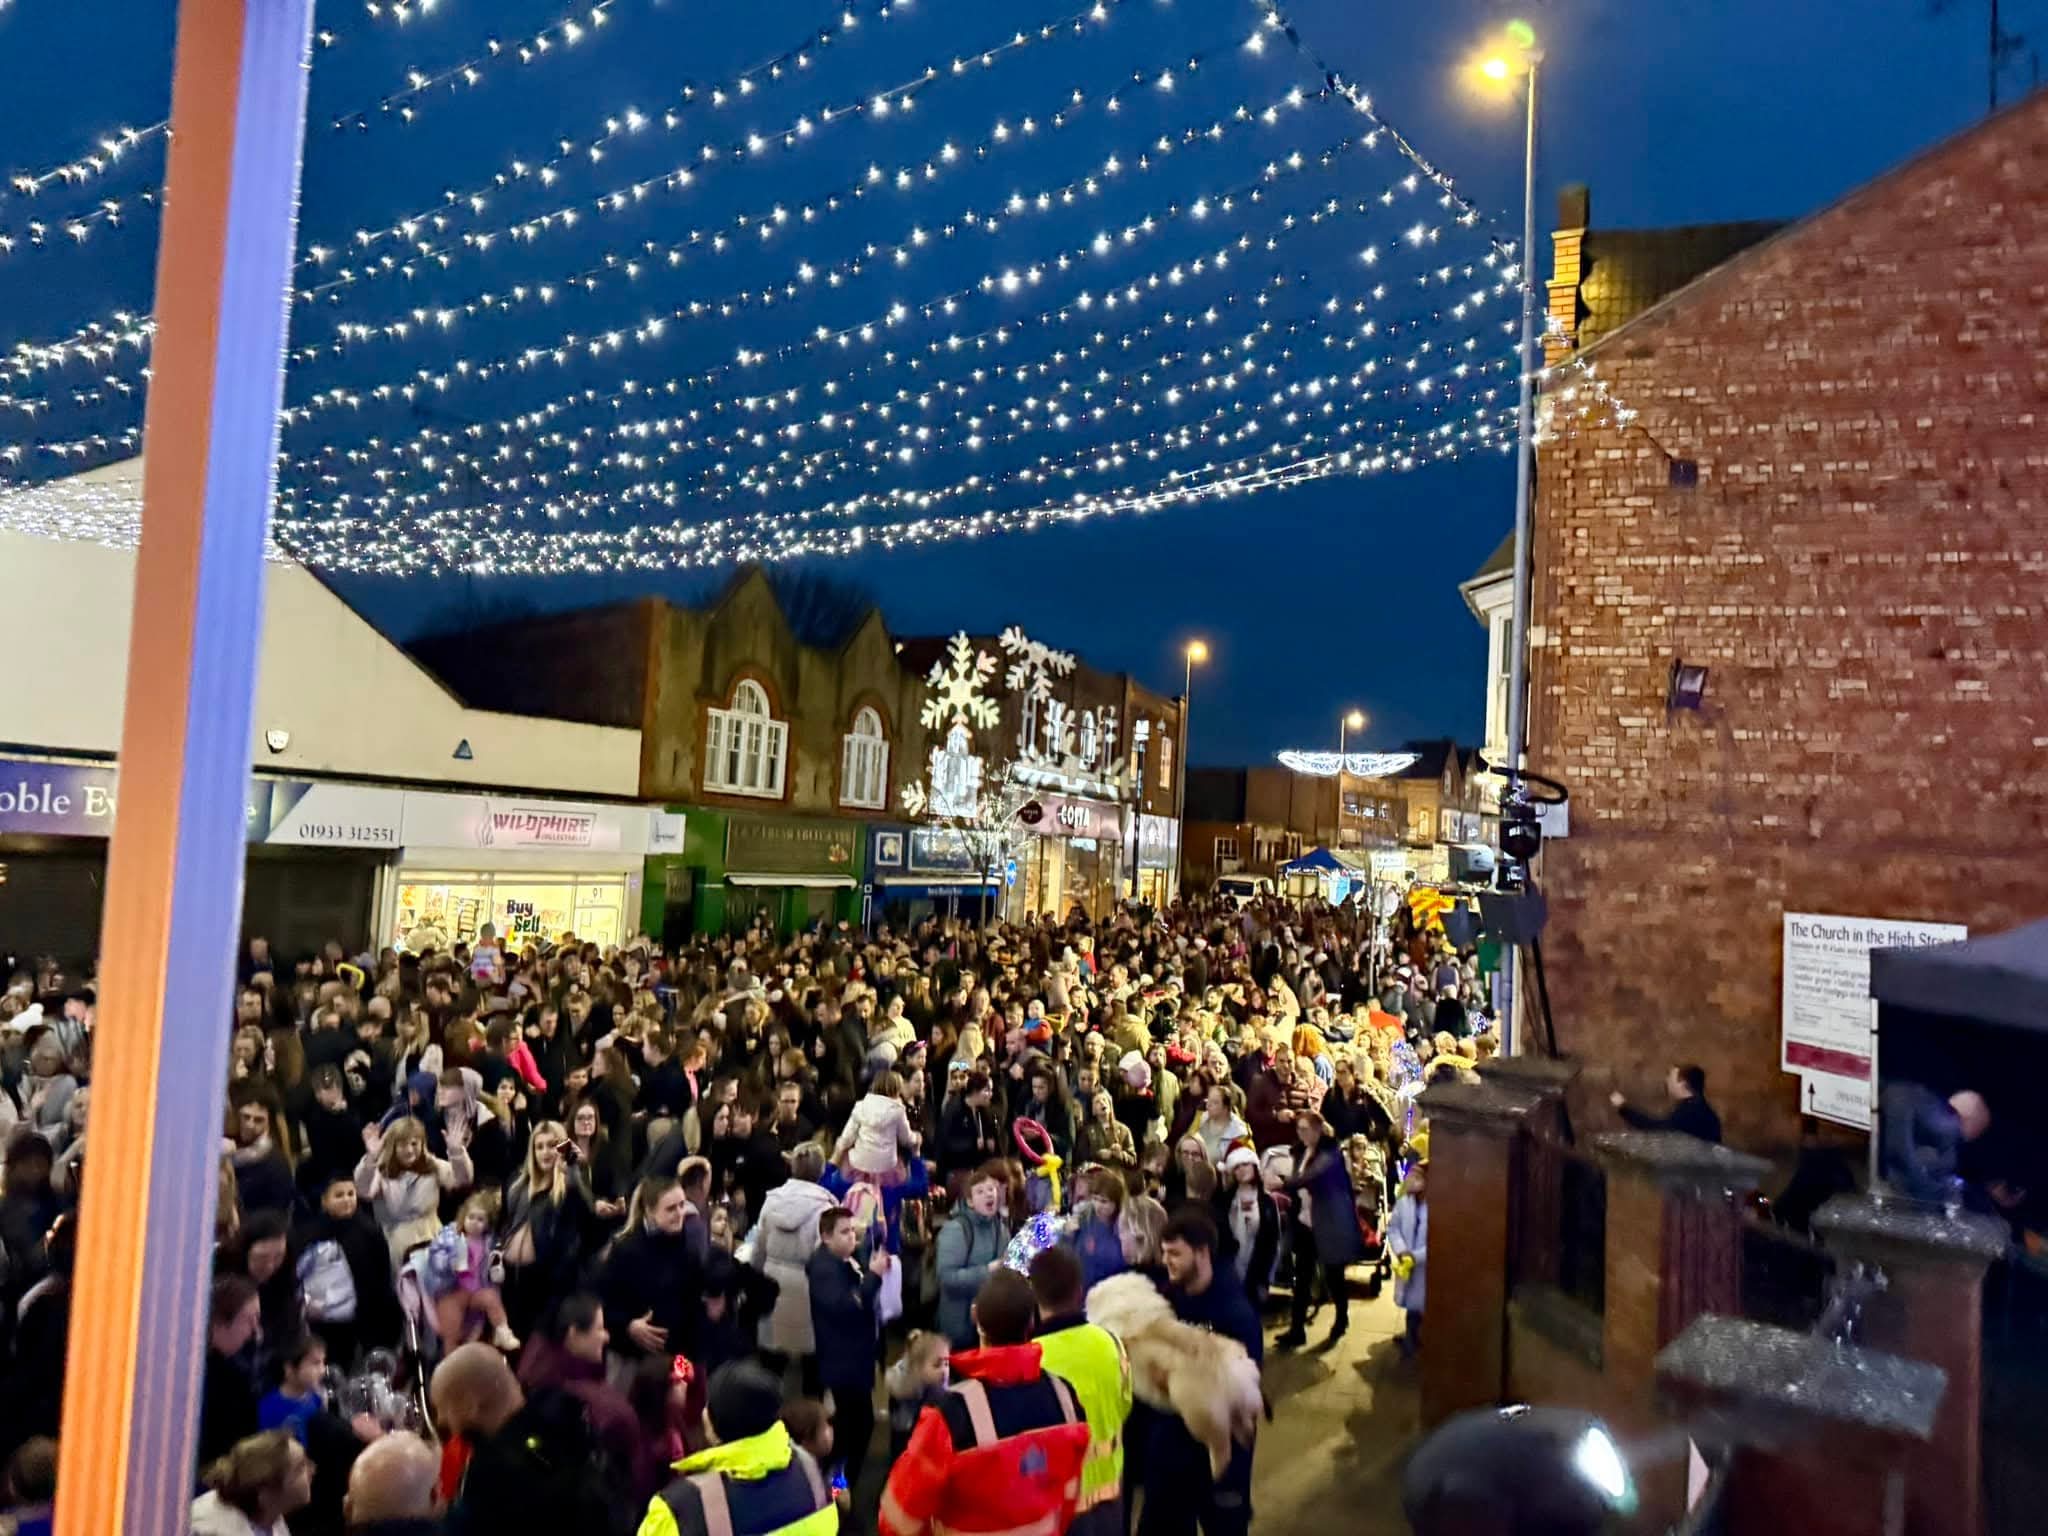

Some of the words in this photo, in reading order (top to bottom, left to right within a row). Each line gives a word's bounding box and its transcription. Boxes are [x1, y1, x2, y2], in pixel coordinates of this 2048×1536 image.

[0, 781, 71, 815] oble
[299, 823, 342, 839] 01933
[350, 825, 394, 842] 312551
[493, 813, 591, 839] WILDPHIRE
[506, 899, 535, 917] Buy
[513, 915, 541, 933] Sell
[1791, 922, 1809, 938] The
[1811, 924, 1850, 942] Church
[1853, 927, 1863, 942] in
[1866, 930, 1885, 945] the
[1888, 930, 1915, 950] High
